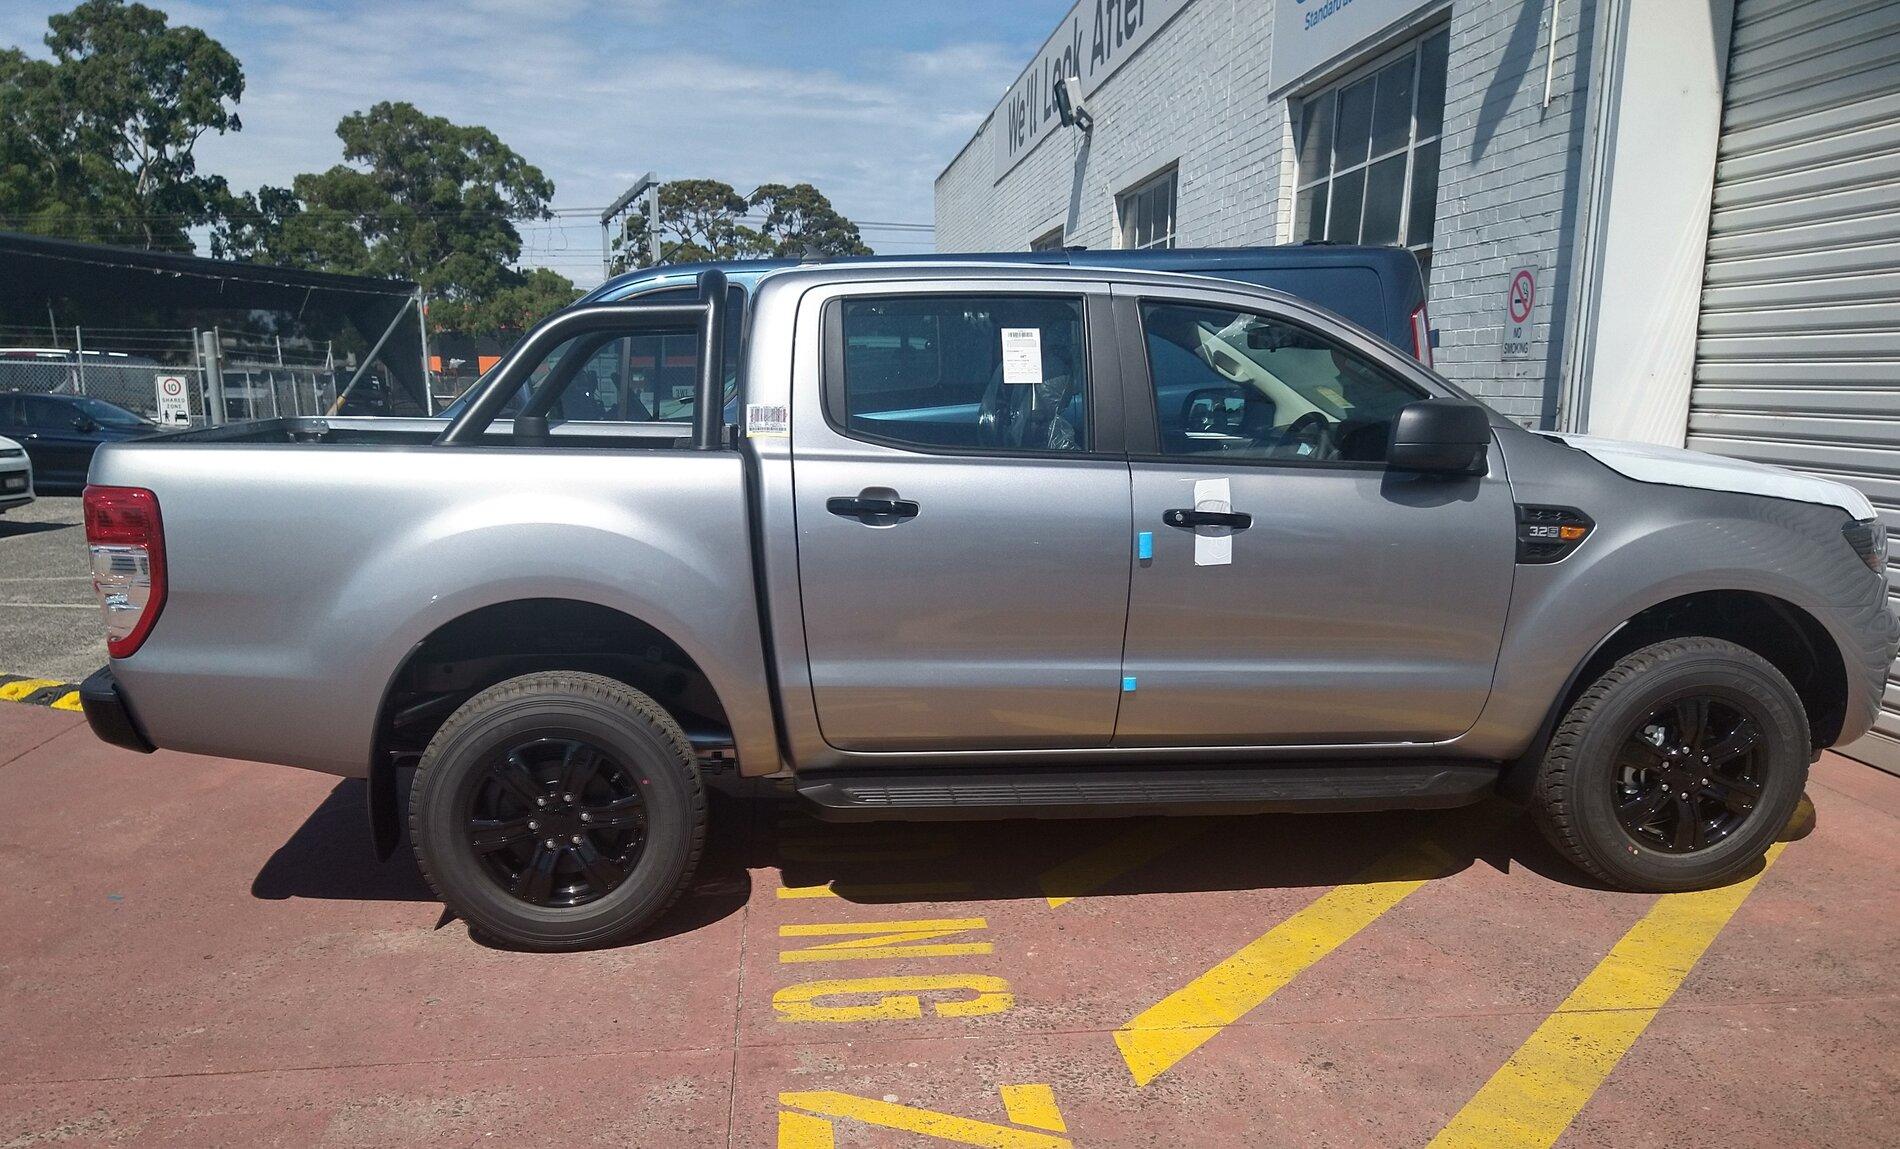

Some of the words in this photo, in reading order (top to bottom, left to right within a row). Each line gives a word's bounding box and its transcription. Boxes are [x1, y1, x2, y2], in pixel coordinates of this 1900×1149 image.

[1008, 68, 1038, 158] We'll
[1513, 327, 1522, 339] NO
[1503, 342, 1529, 354] SMOKING
[168, 383, 177, 391] 10
